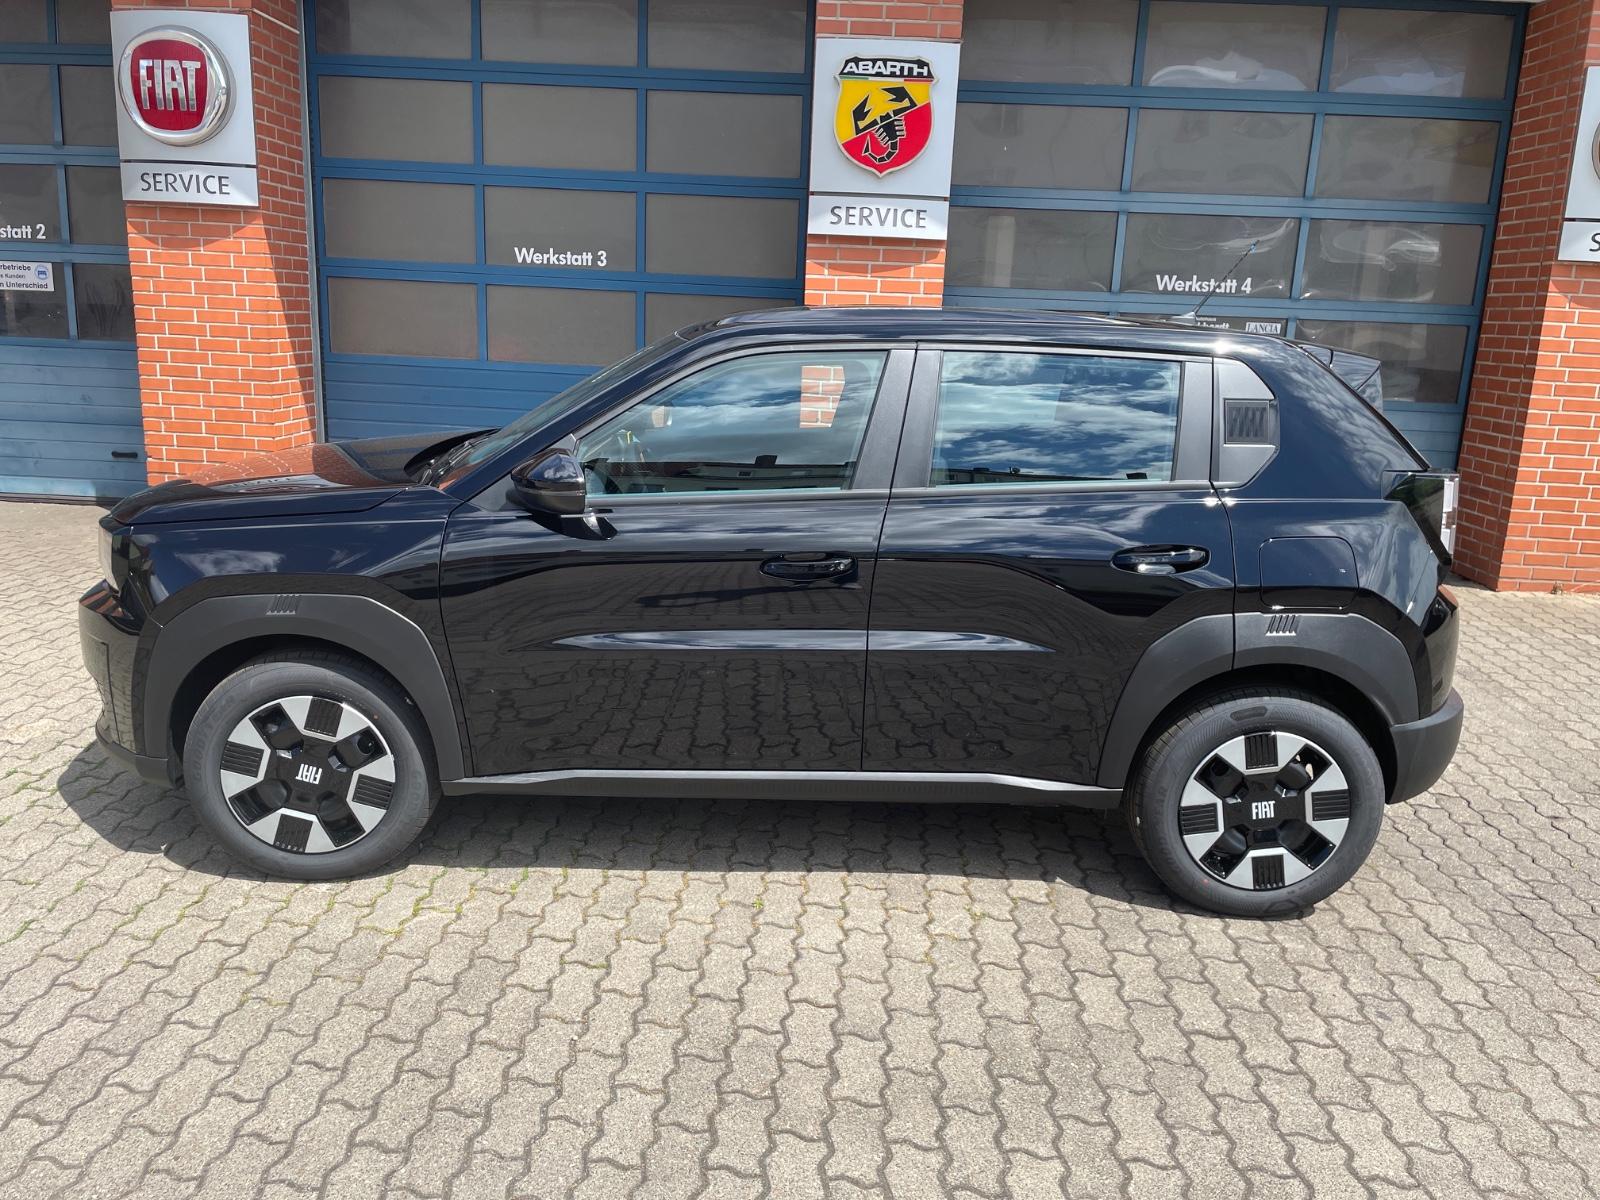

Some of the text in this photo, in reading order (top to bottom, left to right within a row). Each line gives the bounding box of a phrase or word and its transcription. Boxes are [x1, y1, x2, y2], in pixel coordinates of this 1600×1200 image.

[844, 60, 929, 77] ABARTH
[139, 59, 201, 111] FIAT
[140, 172, 231, 196] SERVICE
[829, 205, 928, 229] SERVICE
[36, 223, 46, 239] 2
[514, 247, 607, 267] Werkstatt 3
[6, 281, 48, 289] Unterschied
[1155, 274, 1252, 294] Werkstatt 4
[1248, 323, 1279, 333] LANCIA
[295, 763, 322, 784] FIAT
[1251, 800, 1275, 819] FIAT
